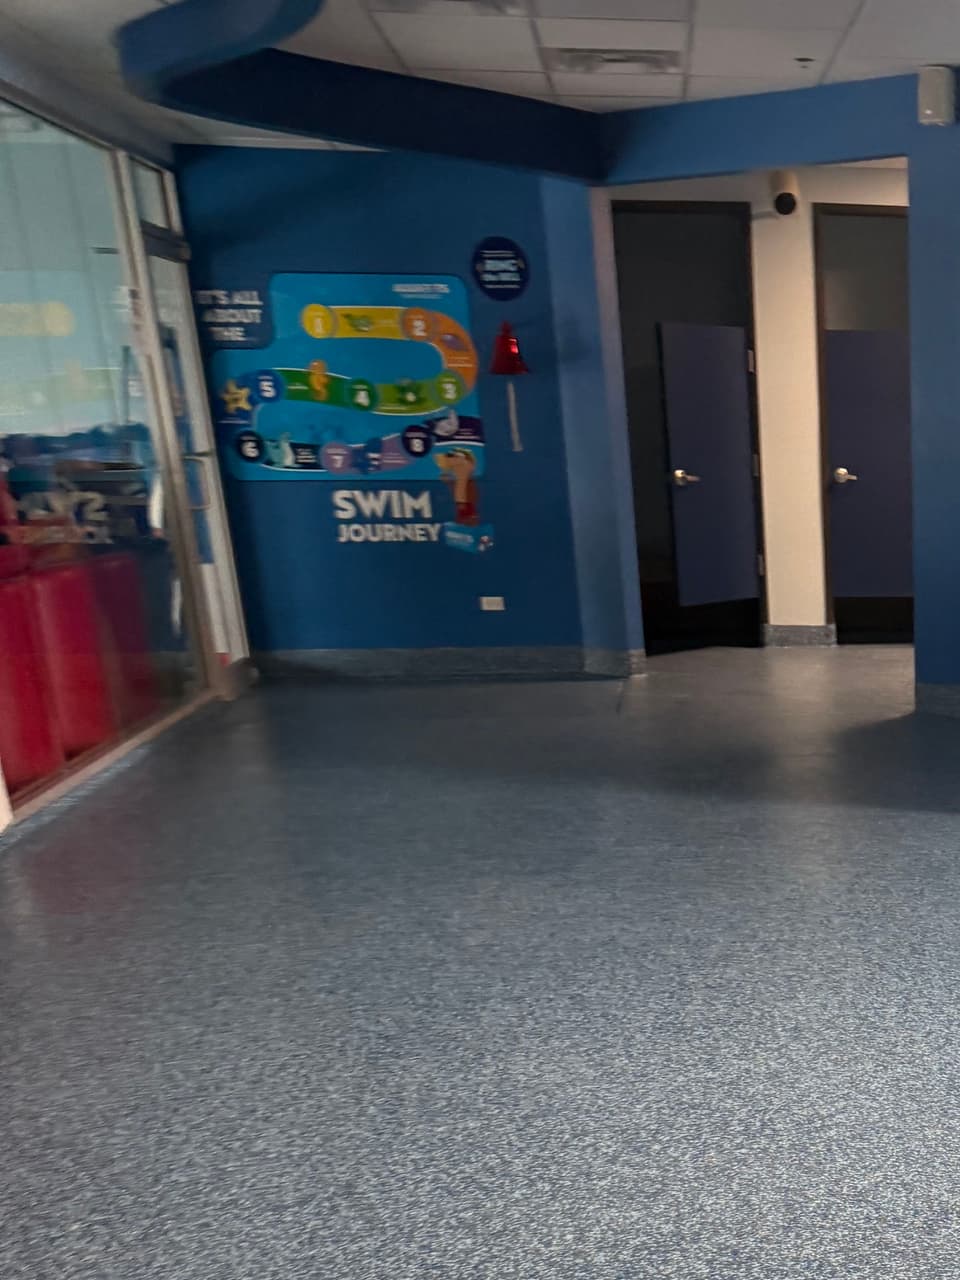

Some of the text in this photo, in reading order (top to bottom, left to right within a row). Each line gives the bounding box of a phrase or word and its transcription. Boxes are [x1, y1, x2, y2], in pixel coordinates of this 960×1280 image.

[313, 318, 324, 334] 1
[414, 320, 428, 337] 2
[260, 382, 276, 398] 5
[355, 390, 370, 406] 4
[445, 384, 457, 400] 3
[244, 440, 260, 457] 6
[334, 491, 432, 519] SWIM
[338, 525, 441, 543] JOURNEY
